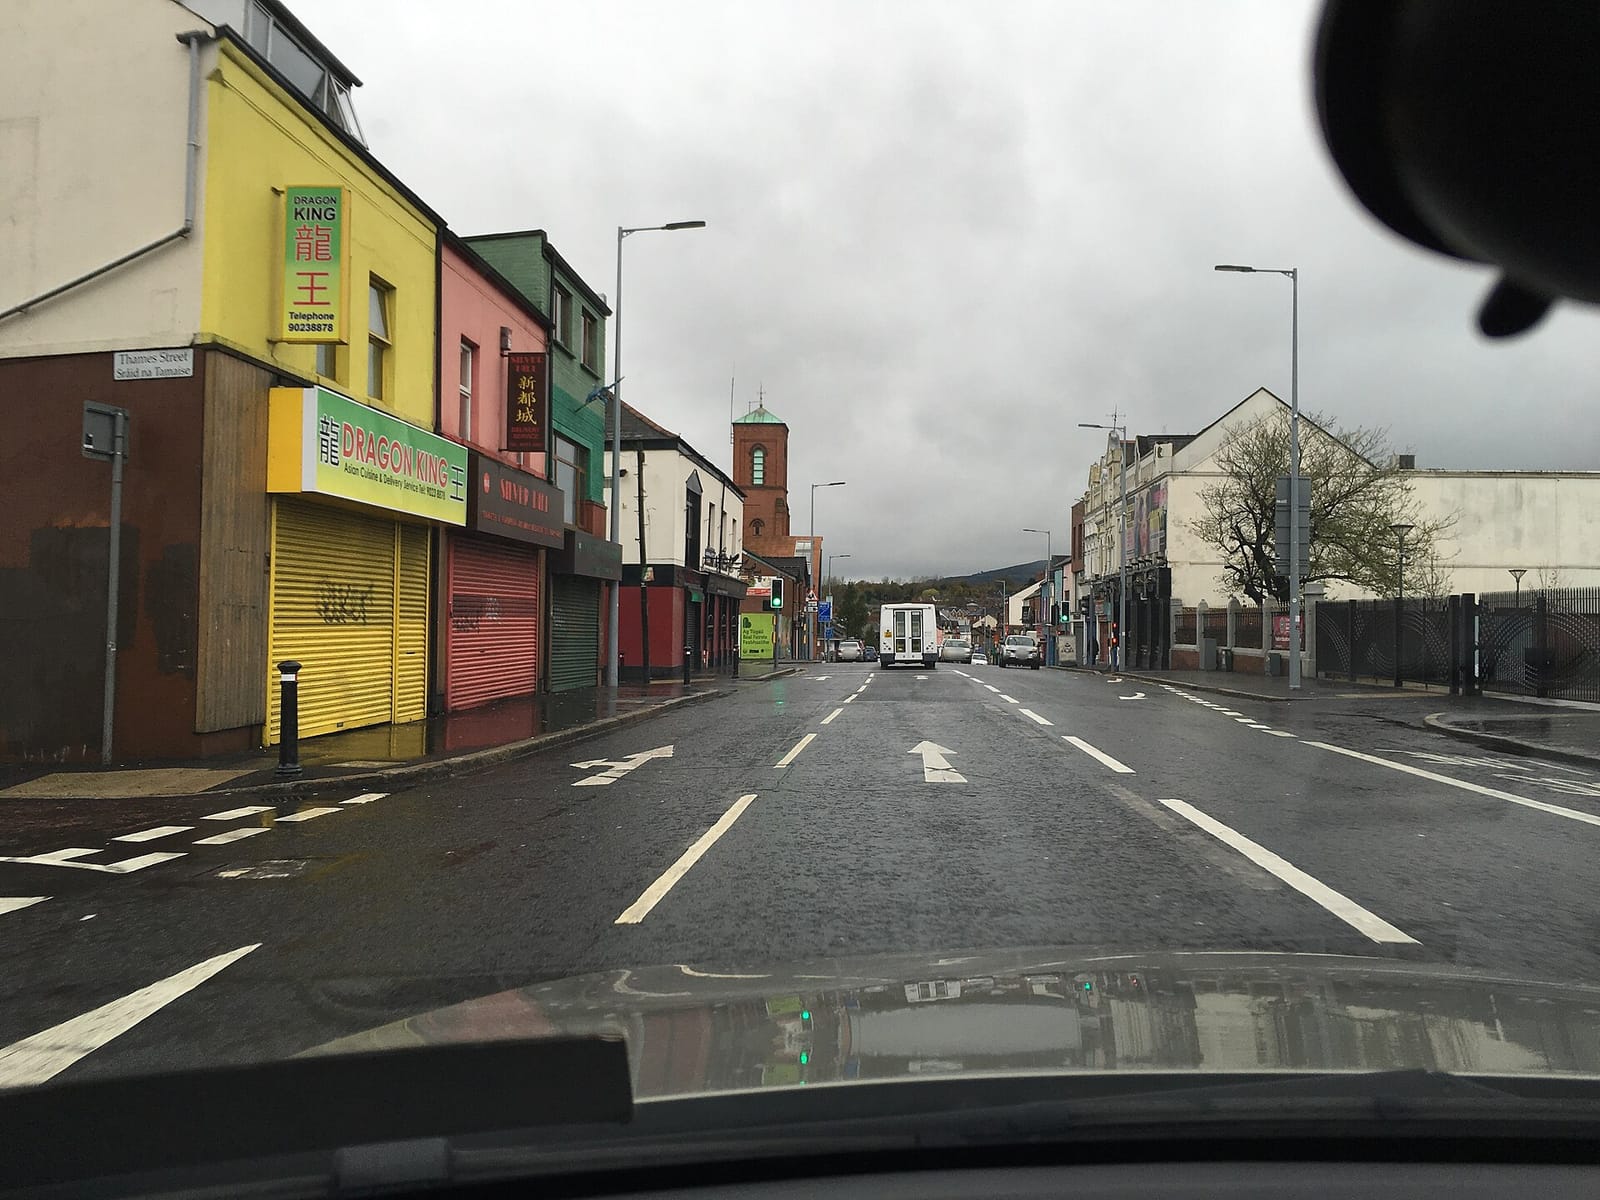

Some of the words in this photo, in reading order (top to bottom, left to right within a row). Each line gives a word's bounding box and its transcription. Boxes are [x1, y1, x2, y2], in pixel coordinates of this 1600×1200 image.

[294, 196, 337, 205] DRAGON
[294, 207, 336, 221] KING
[293, 224, 332, 306] 龍王
[289, 311, 335, 321] Telephone
[288, 323, 334, 332] 90238878
[118, 353, 157, 365] Thames
[159, 351, 188, 363] Street
[141, 369, 152, 377] na
[516, 375, 537, 425] 新都城
[320, 414, 340, 466] 龍
[342, 423, 413, 477] DRAGON
[416, 450, 448, 488] KING
[344, 462, 359, 476] Asian
[360, 466, 378, 481] Cuisine
[384, 474, 402, 490] Delivery
[403, 479, 418, 493] Service
[450, 465, 464, 502] 王
